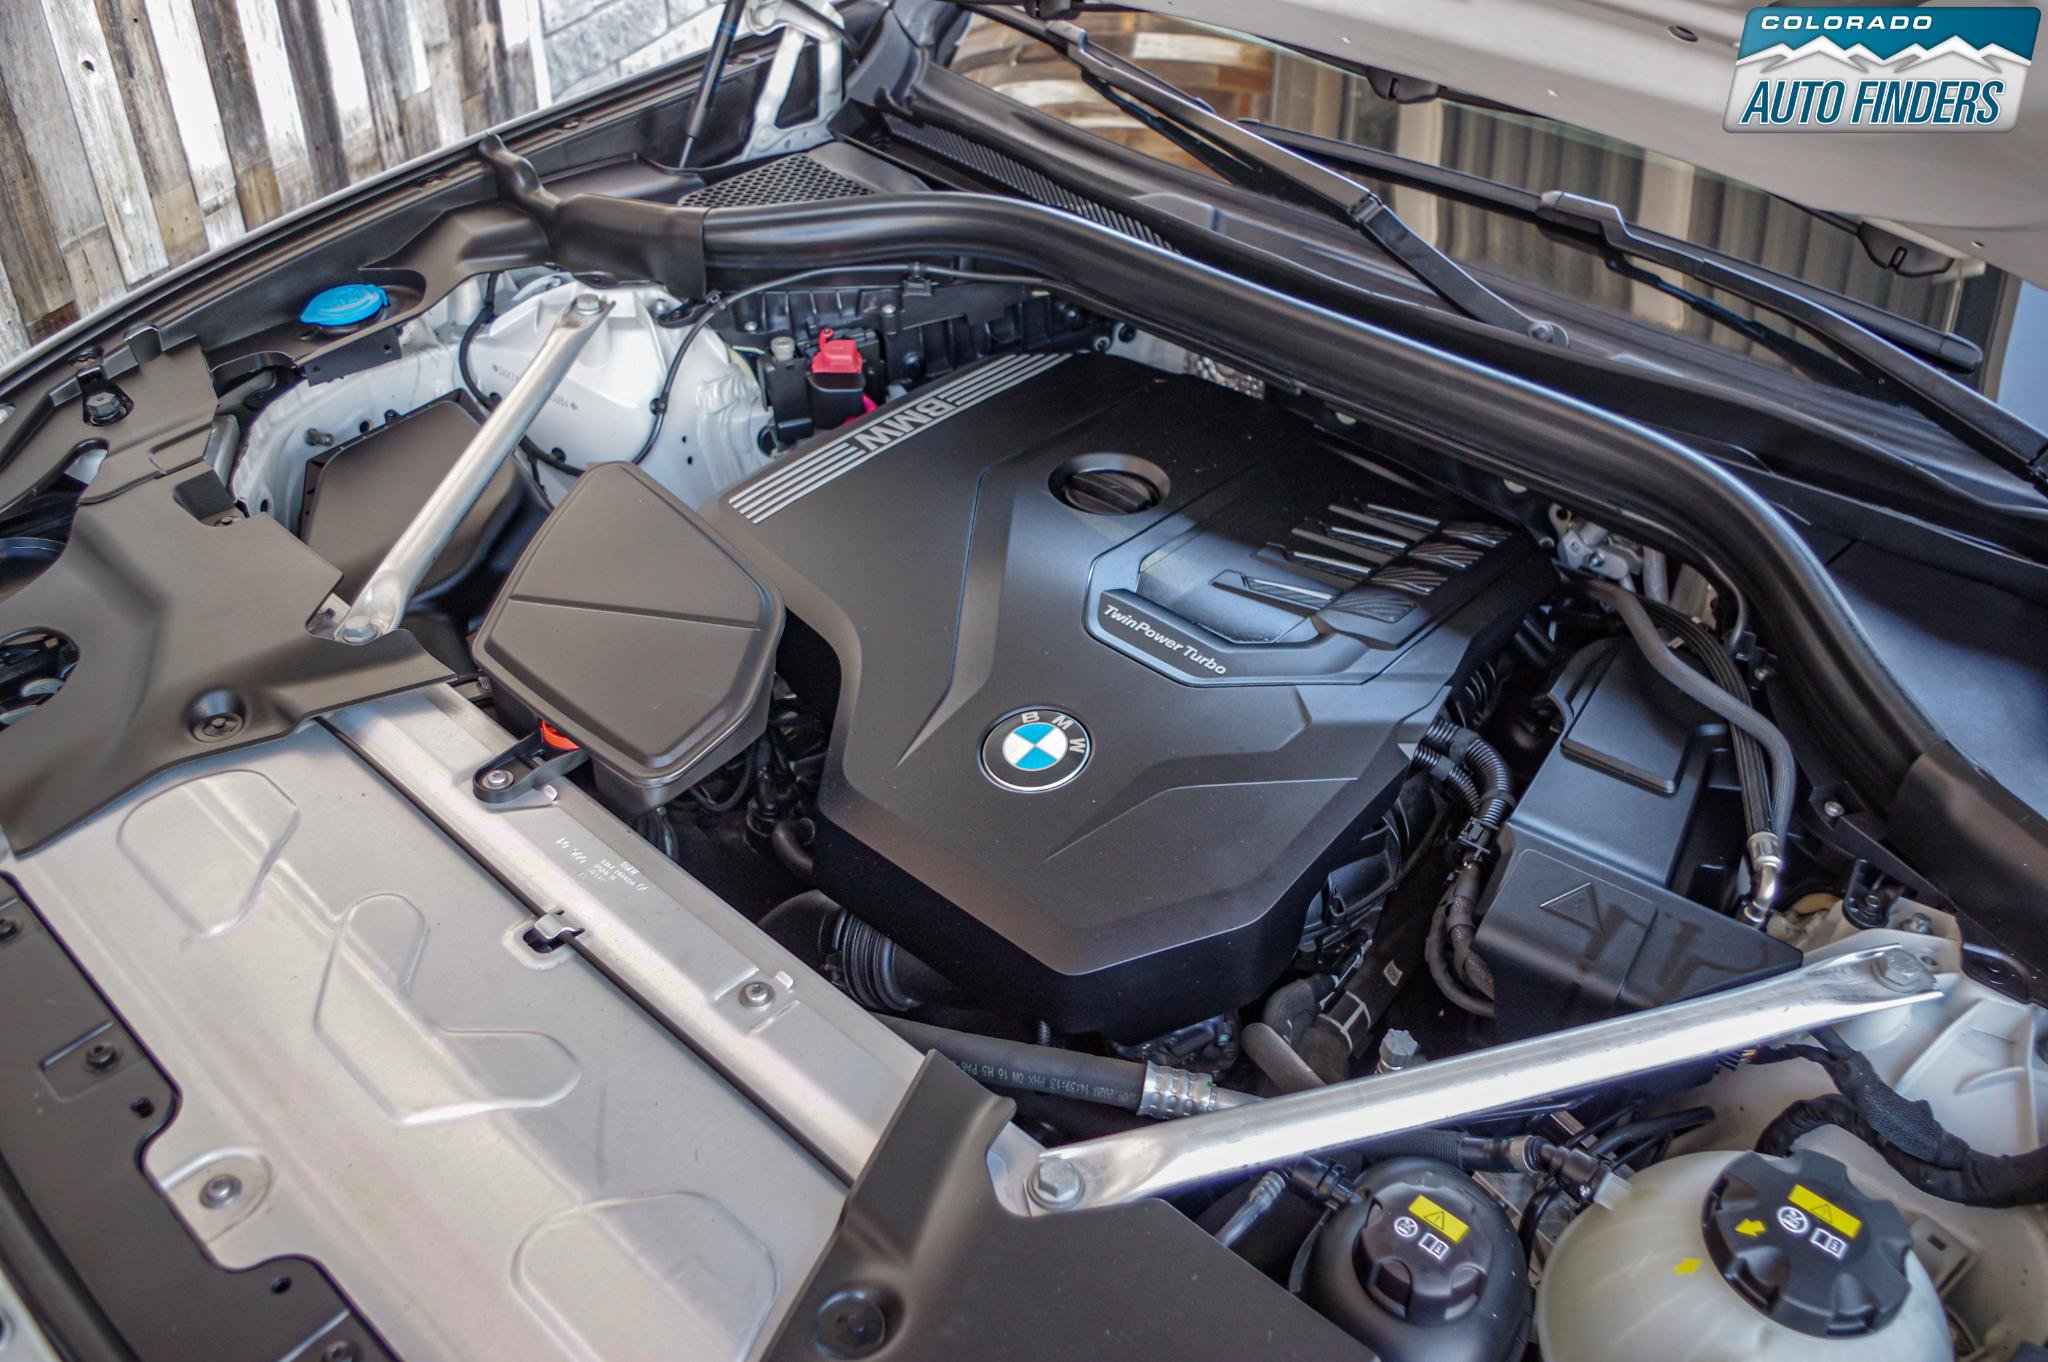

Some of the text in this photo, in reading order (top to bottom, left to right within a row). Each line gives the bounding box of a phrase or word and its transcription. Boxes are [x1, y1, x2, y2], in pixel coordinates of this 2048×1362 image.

[855, 397, 955, 451] BMW
[1104, 604, 1226, 675] TwinPower Turbo
[1021, 711, 1086, 754] BMW
